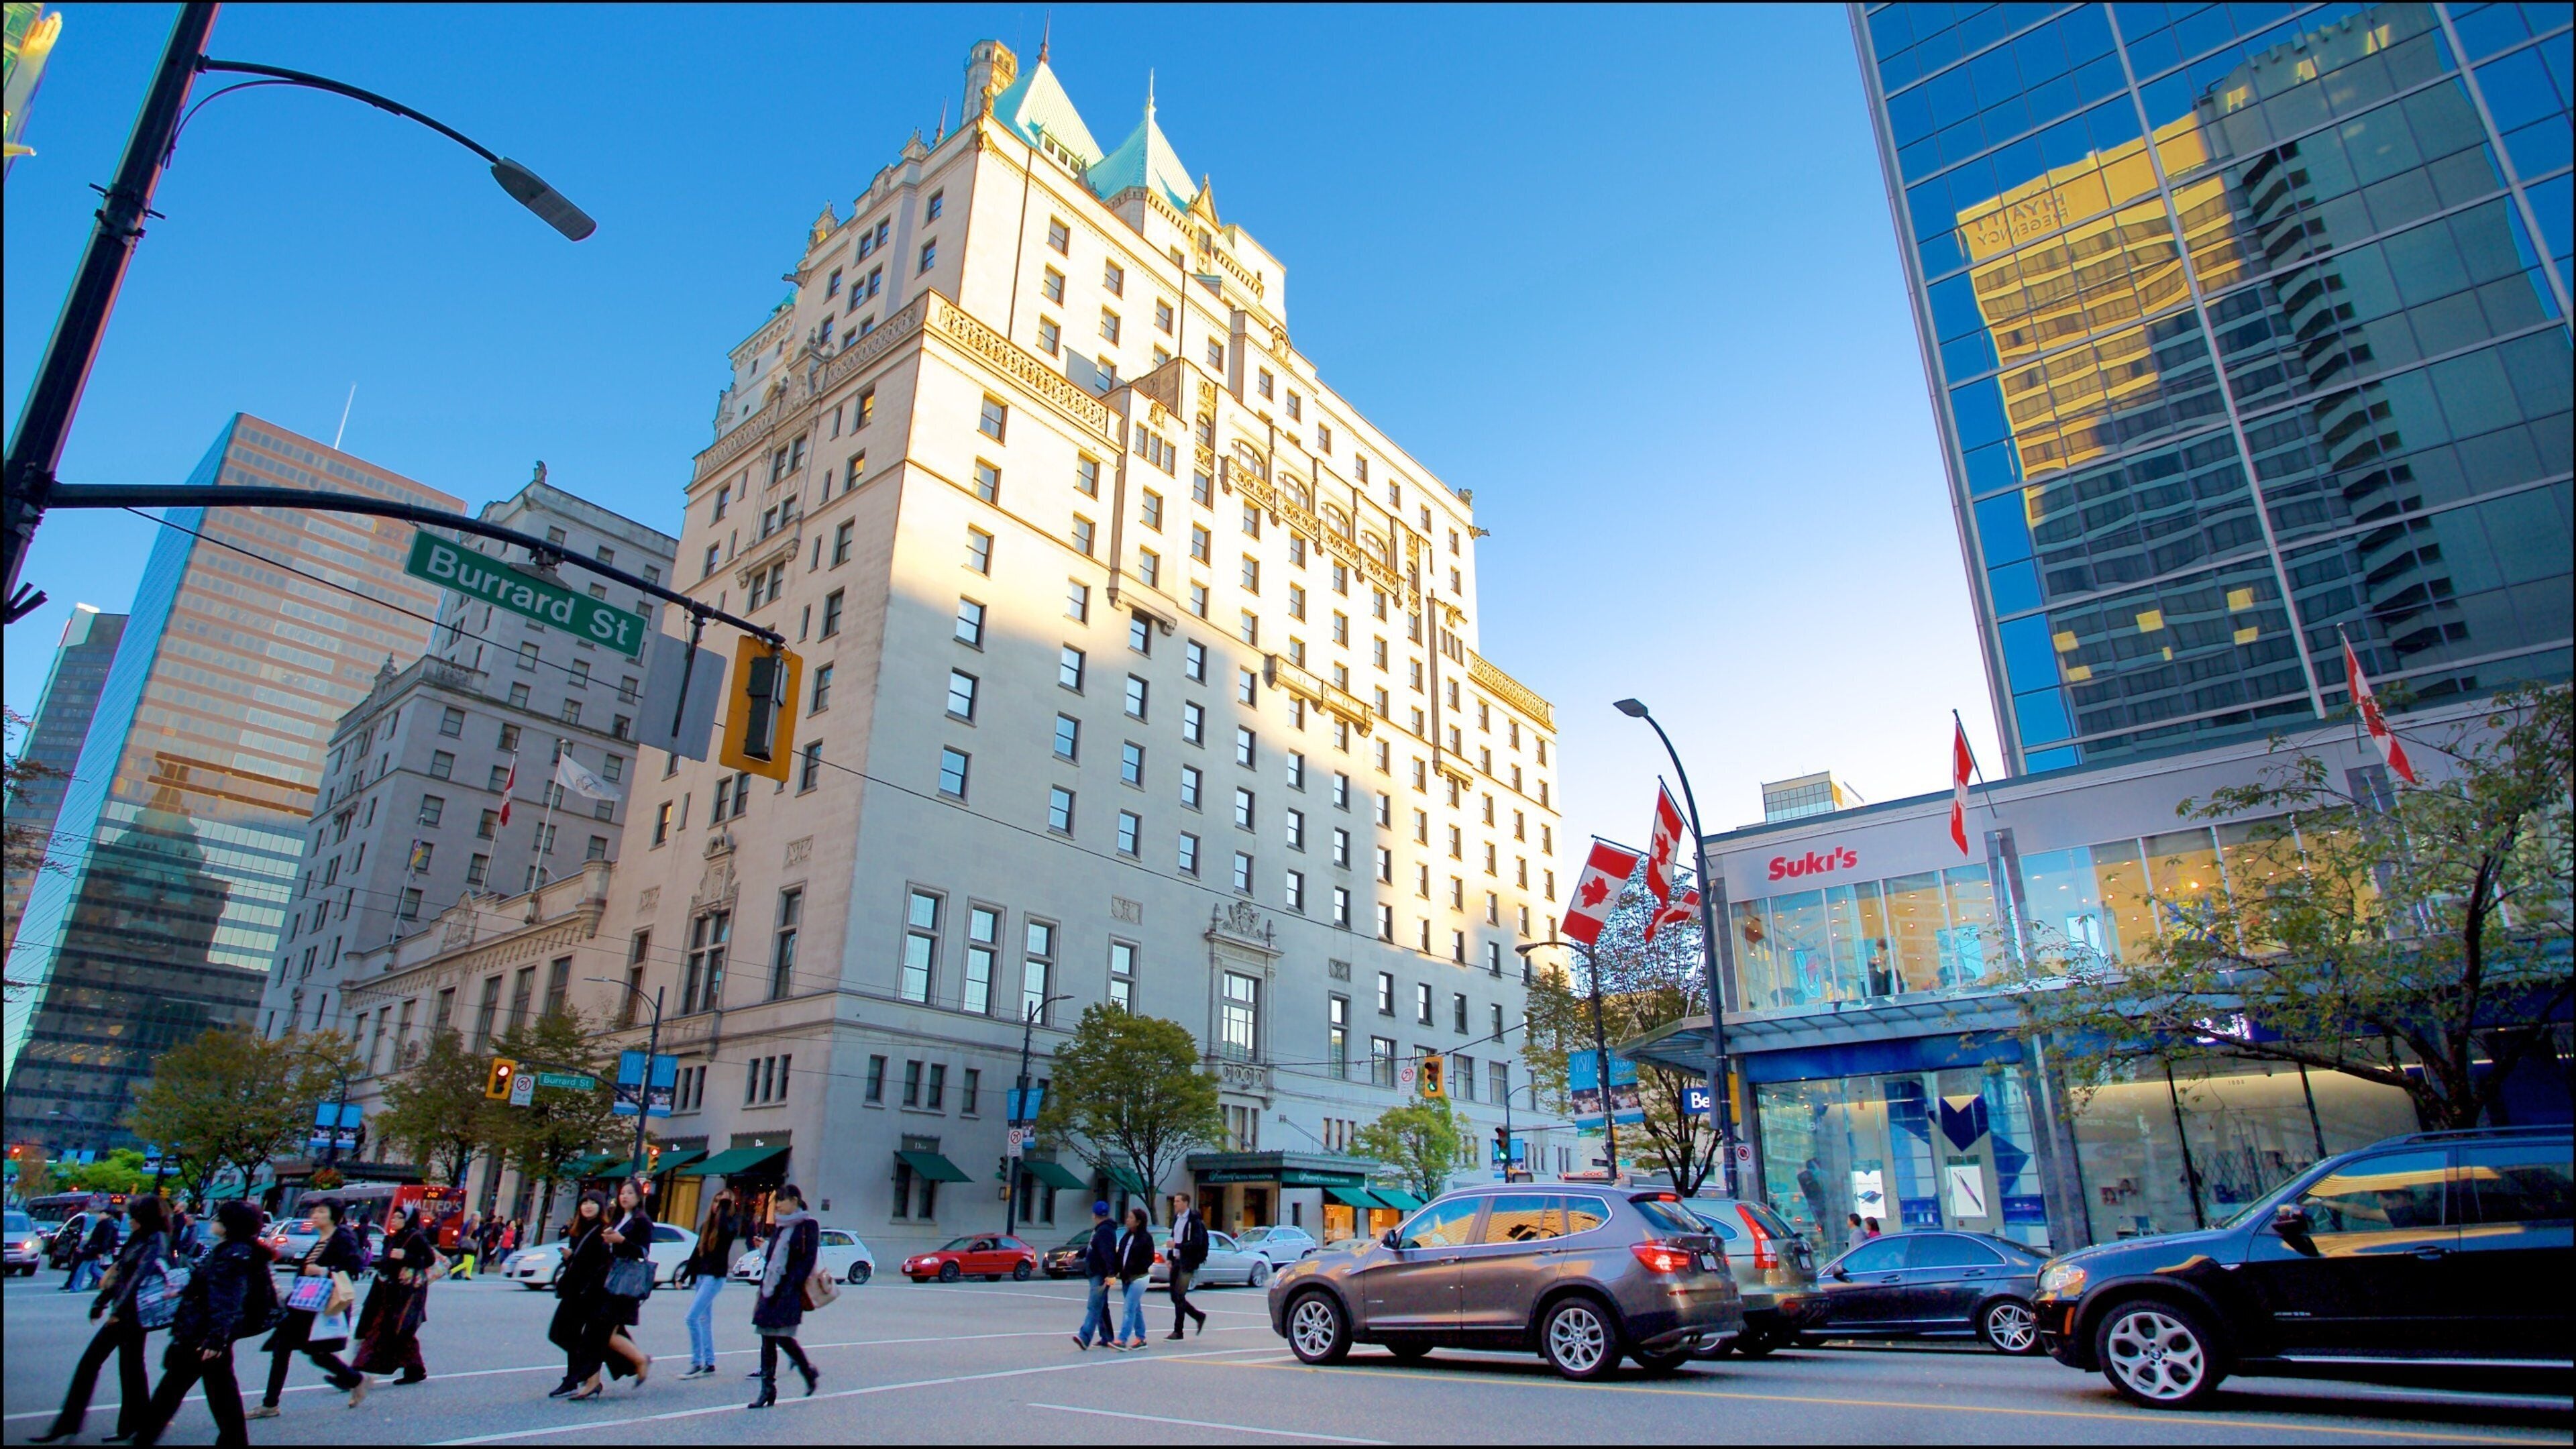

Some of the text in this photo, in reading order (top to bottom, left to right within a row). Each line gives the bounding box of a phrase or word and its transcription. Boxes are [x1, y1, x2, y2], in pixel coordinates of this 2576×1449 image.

[427, 544, 629, 645] Burrard St
[1768, 846, 1858, 881] Suki's
[1576, 1054, 1591, 1073] VSO
[543, 1075, 589, 1087] Burrard St
[914, 1142, 927, 1150] Dior
[402, 1197, 462, 1213] WALTER'S
